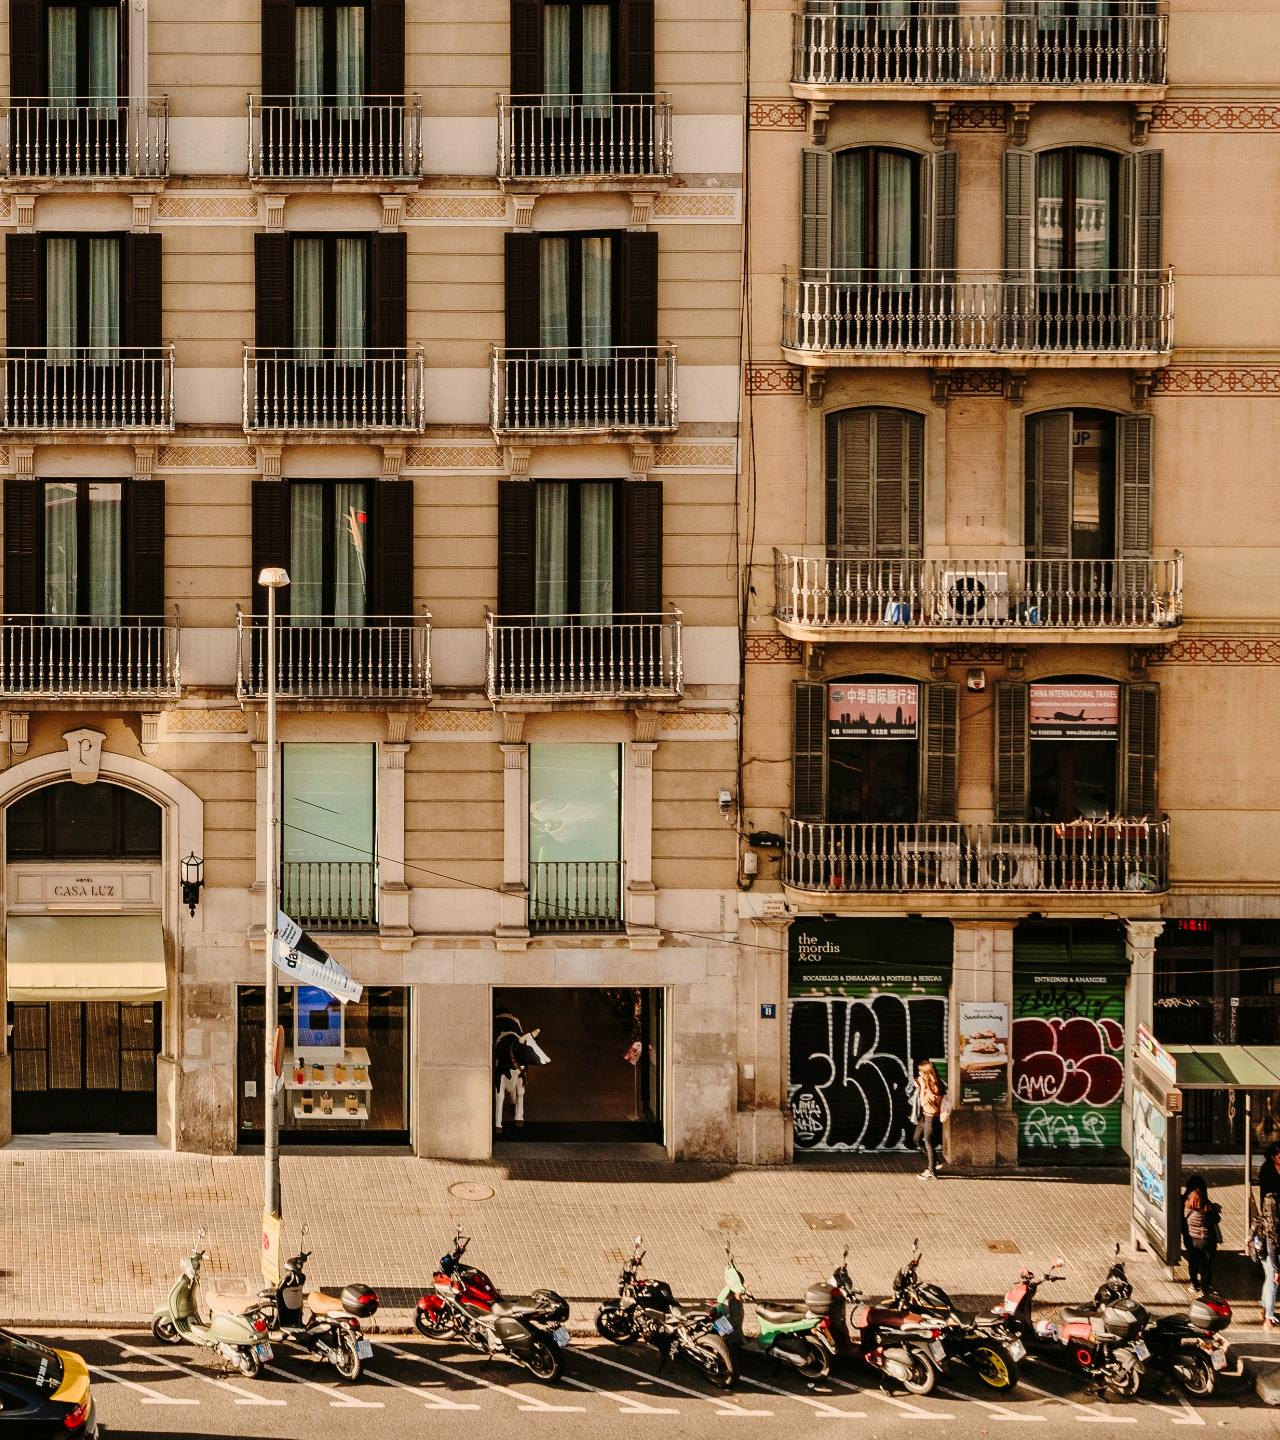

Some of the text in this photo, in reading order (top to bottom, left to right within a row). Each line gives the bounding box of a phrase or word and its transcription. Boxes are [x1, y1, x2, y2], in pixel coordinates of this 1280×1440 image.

[1030, 690, 1048, 698] CHINA
[1095, 690, 1118, 698] TRAVEL
[54, 885, 114, 897] CASA LUZ
[798, 932, 818, 945] the
[798, 941, 840, 953] mordis
[1074, 976, 1108, 984] AMANIDES
[1017, 1073, 1058, 1100] AMC
